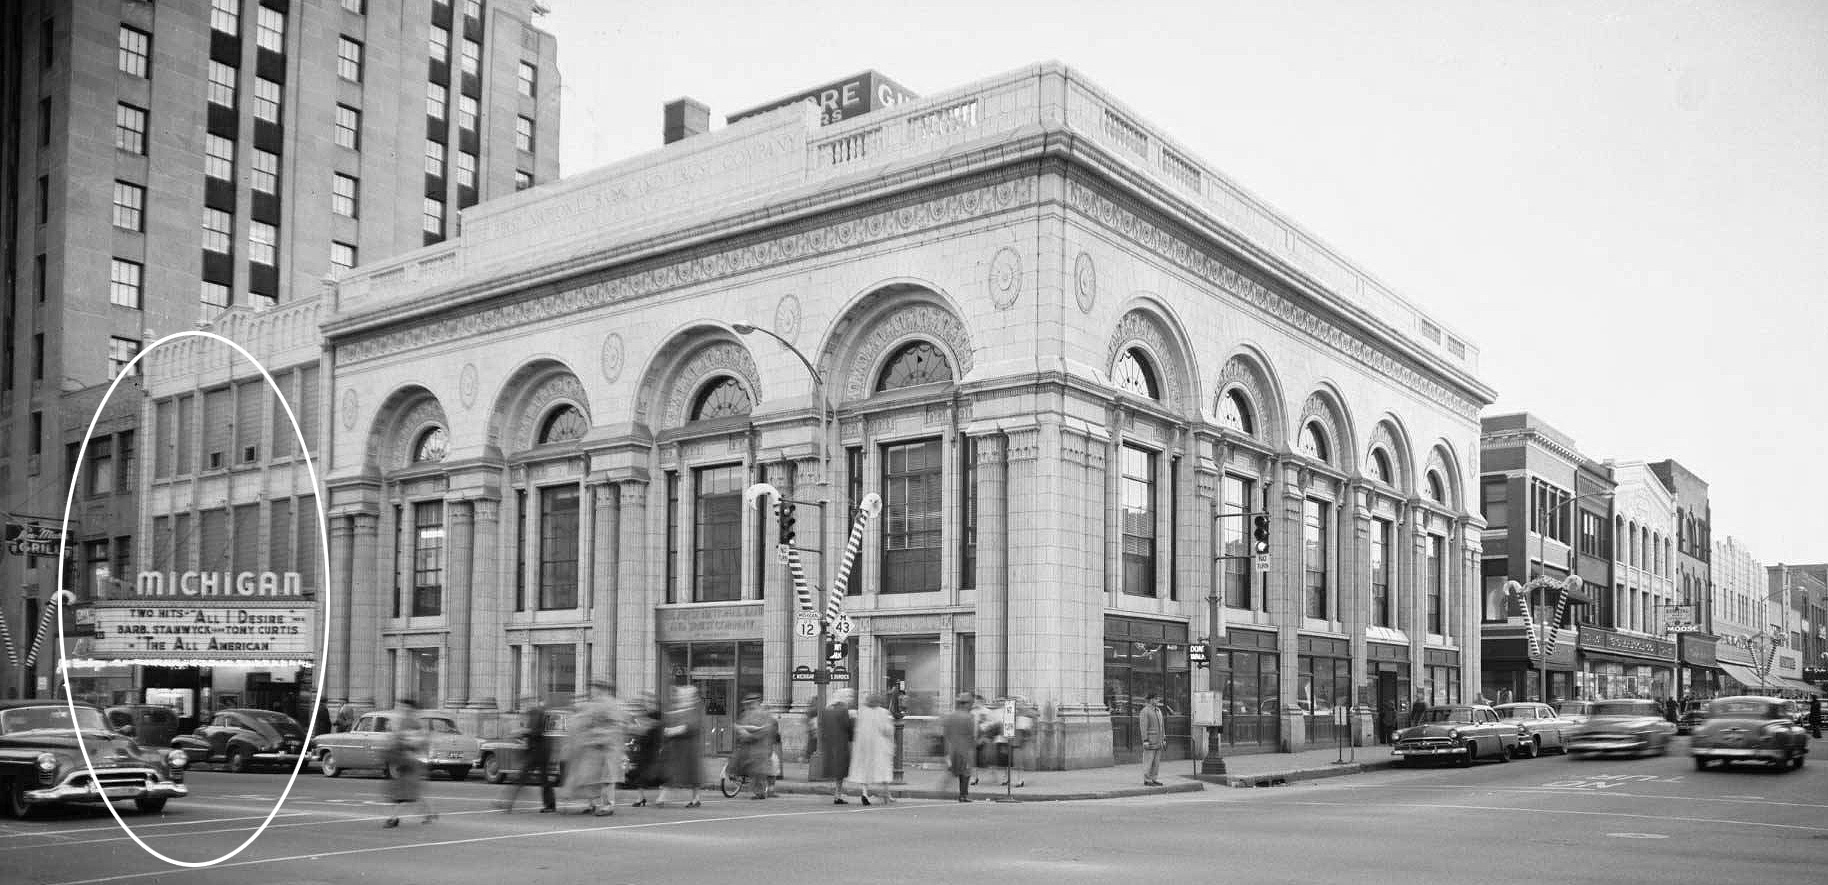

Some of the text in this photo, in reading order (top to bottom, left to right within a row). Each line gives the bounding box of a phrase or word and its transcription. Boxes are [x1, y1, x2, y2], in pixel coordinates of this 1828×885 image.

[136, 570, 301, 597] MICHIGAN
[129, 609, 154, 618] TWO
[152, 625, 211, 634] STANWYCK
[225, 625, 255, 634] TONY
[258, 625, 299, 634] CURTIS
[802, 623, 814, 636] 12
[835, 622, 850, 633] 43
[173, 636, 199, 650] ALL
